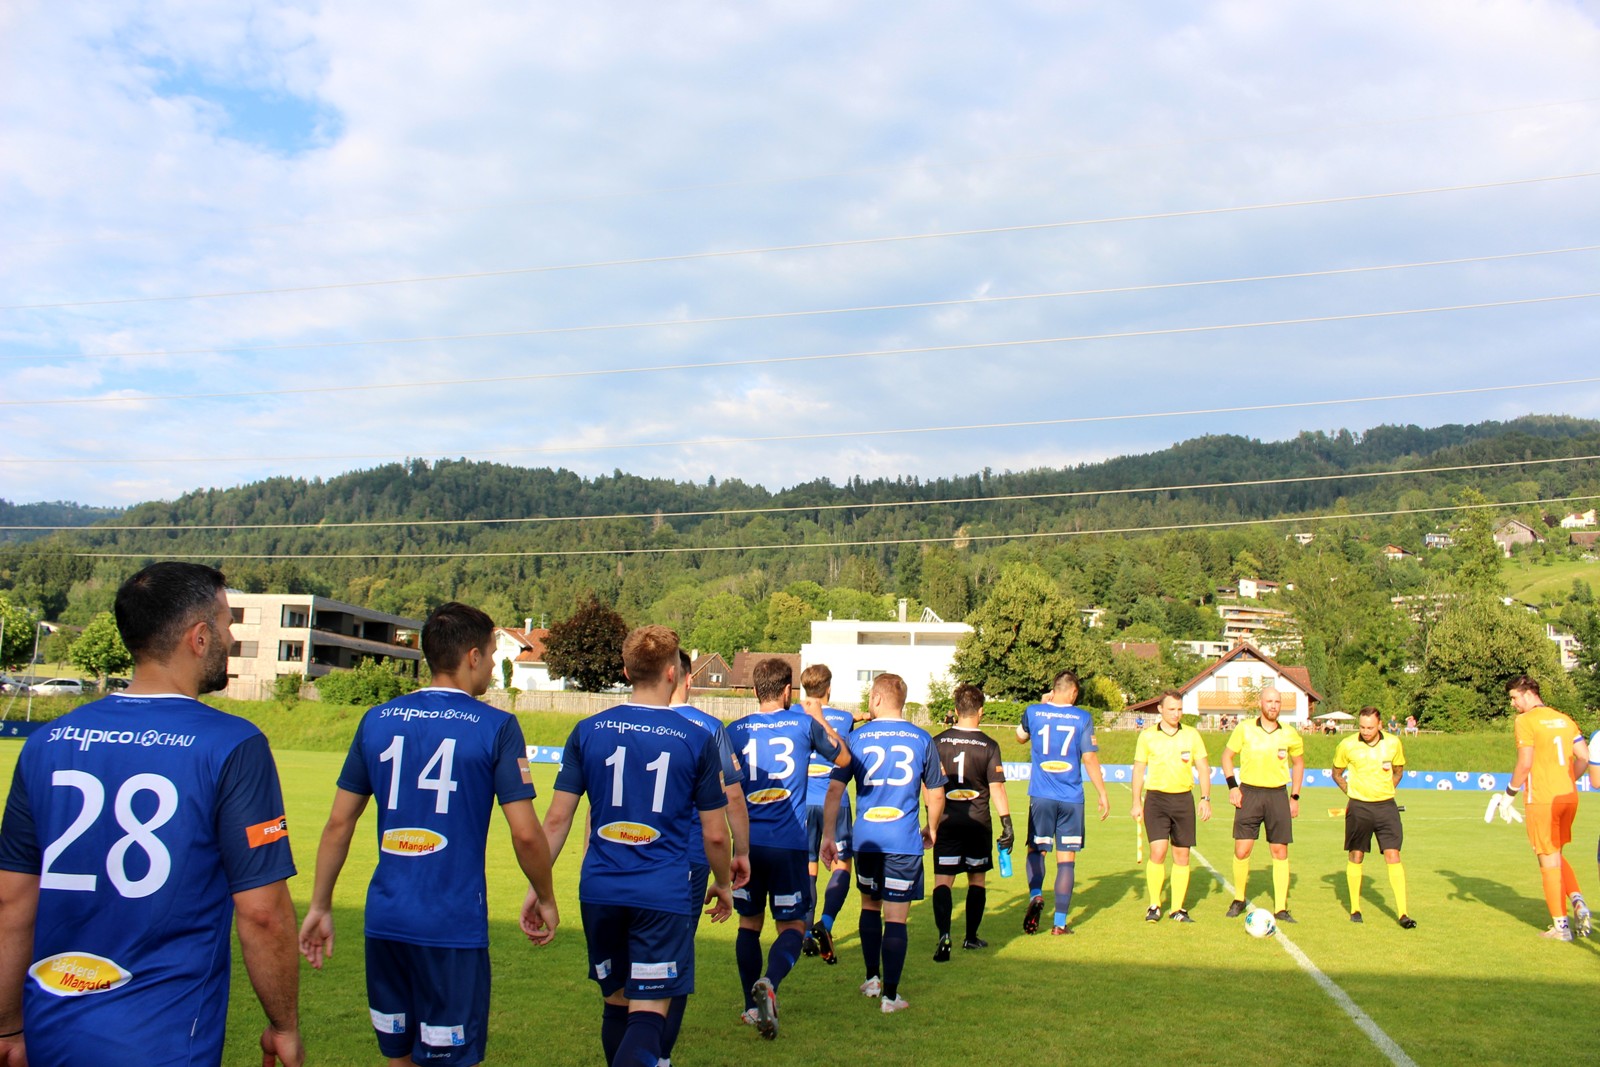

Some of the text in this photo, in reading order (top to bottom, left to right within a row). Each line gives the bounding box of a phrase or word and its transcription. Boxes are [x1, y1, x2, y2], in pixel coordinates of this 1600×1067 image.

[379, 707, 481, 723] SV typico LOCHAU
[594, 720, 687, 739] SV typico LOCHAU
[47, 725, 196, 751] SV typico LOCHAU
[1037, 724, 1075, 757] 17
[1553, 735, 1566, 767] 1
[379, 735, 458, 814] 14
[742, 736, 795, 781] 13
[862, 744, 914, 787] 23
[952, 751, 965, 784] 1
[605, 745, 671, 813] 11
[40, 769, 179, 899] 28
[398, 840, 435, 853] Mangold
[51, 957, 100, 979] Bäckerei
[59, 972, 111, 992] Mangold
